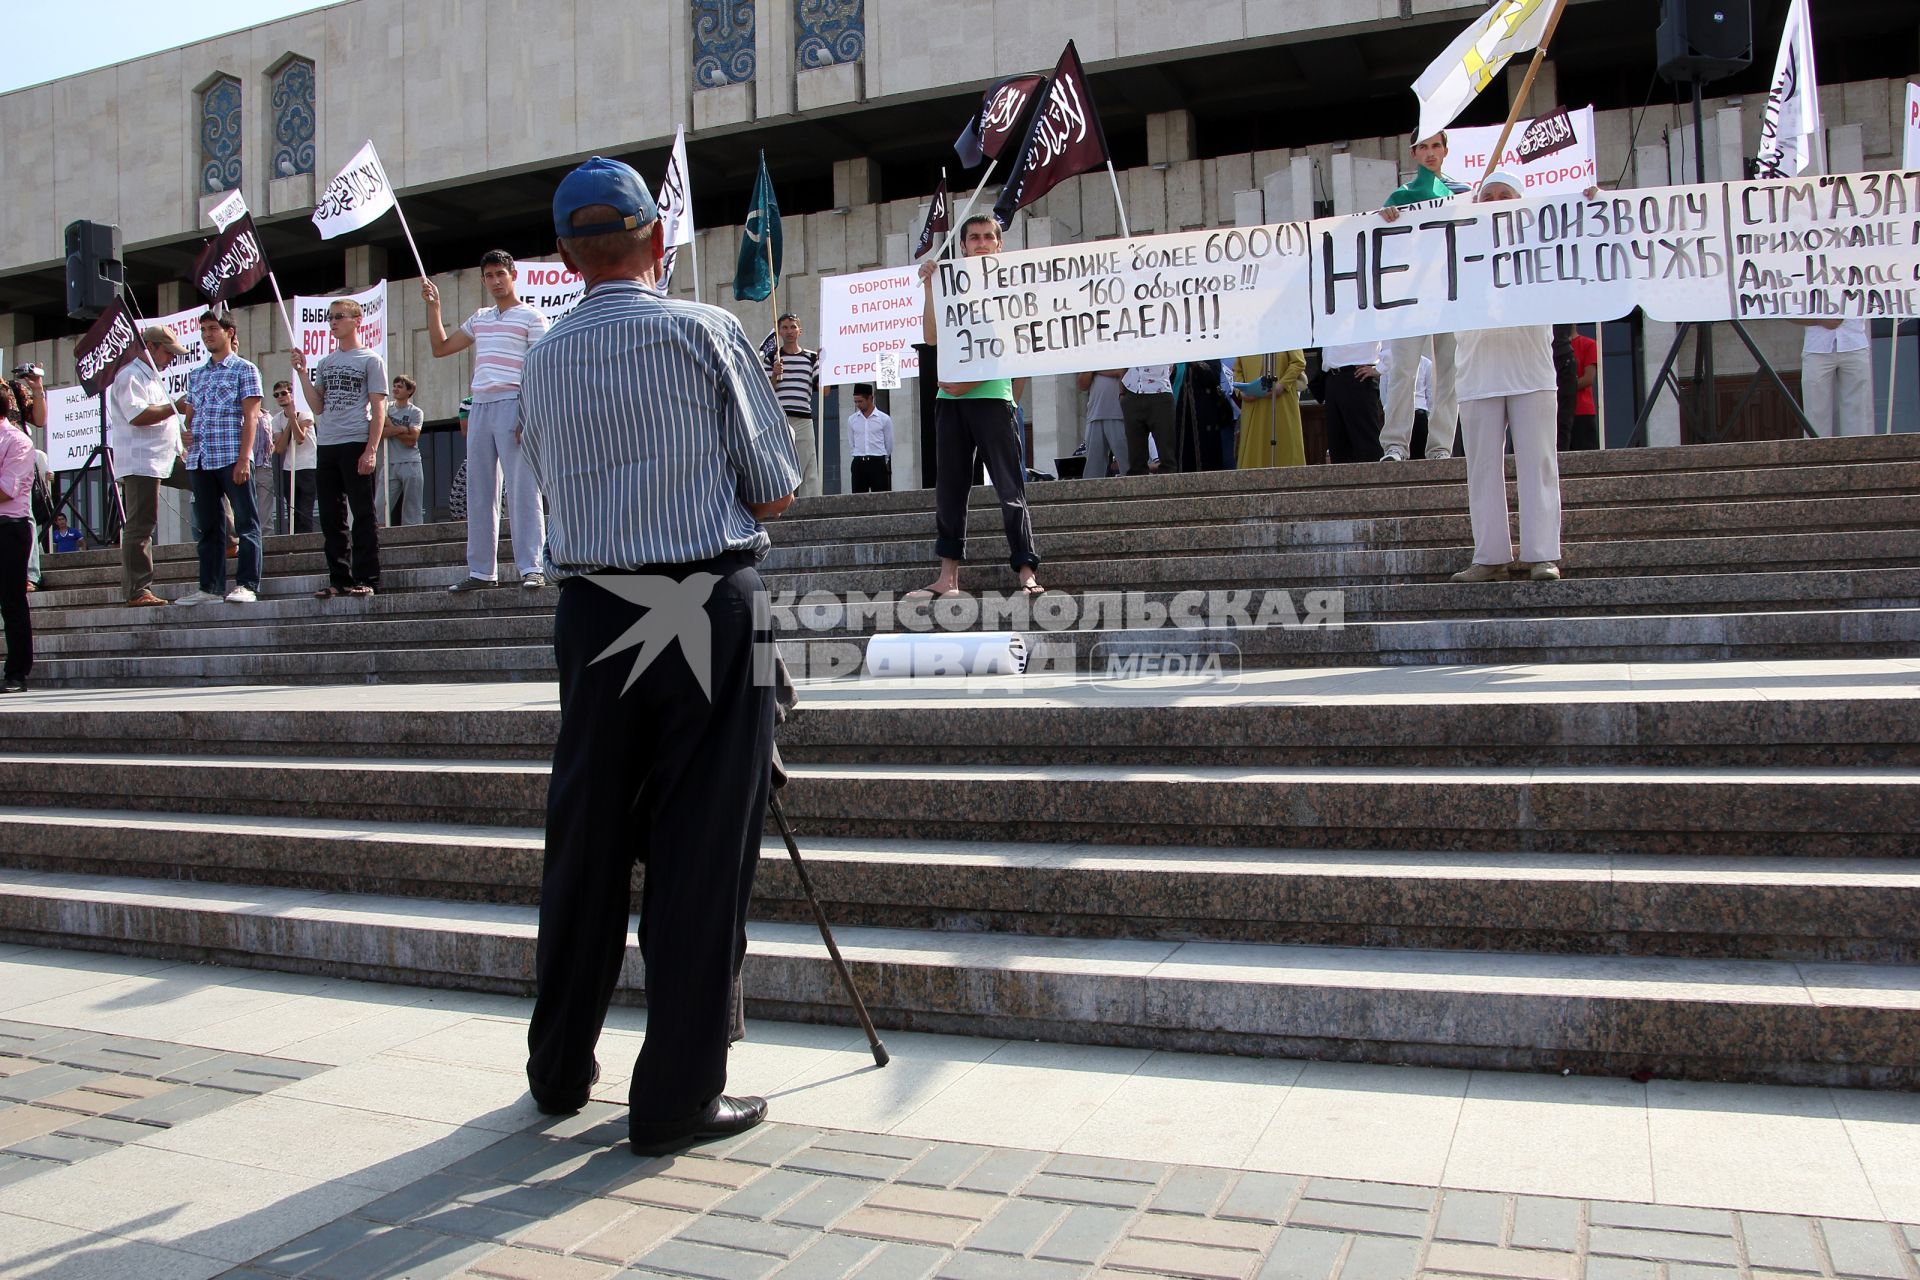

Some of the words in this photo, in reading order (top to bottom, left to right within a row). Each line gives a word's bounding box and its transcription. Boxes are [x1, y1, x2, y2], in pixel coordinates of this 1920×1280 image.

[1464, 154, 1486, 168] НЕ
[1525, 158, 1595, 188] ВТОРОЙ
[1492, 192, 1707, 249] ПРОИЗВОЛУ
[1736, 221, 1903, 255] ПРИХОЖАНЕ
[527, 270, 583, 285] МОСК
[849, 276, 910, 294] ОБОРОТНИ
[851, 304, 858, 314] В
[862, 296, 913, 313] ПАГОНАХ
[946, 291, 1038, 327] АРЕСТОВ
[1053, 297, 1072, 312] и
[1079, 276, 1126, 307] 160
[1740, 288, 1919, 317] МУСУЛЬМАНЕ
[839, 315, 924, 335] ИММИТИРУЮТ
[1013, 293, 1220, 355] БЕСПРЕДЕЛ!!!
[303, 330, 326, 355] ВОТ
[862, 339, 906, 353] БОРЬБУ
[834, 366, 840, 375] С
[844, 358, 919, 375] ТЕРРОМО
[66, 394, 80, 404] НАС
[65, 413, 73, 422] НЕ
[75, 407, 102, 420] ЗАПУГАЕ
[52, 432, 65, 440] МЫ
[67, 427, 93, 438] БОИМСЯ
